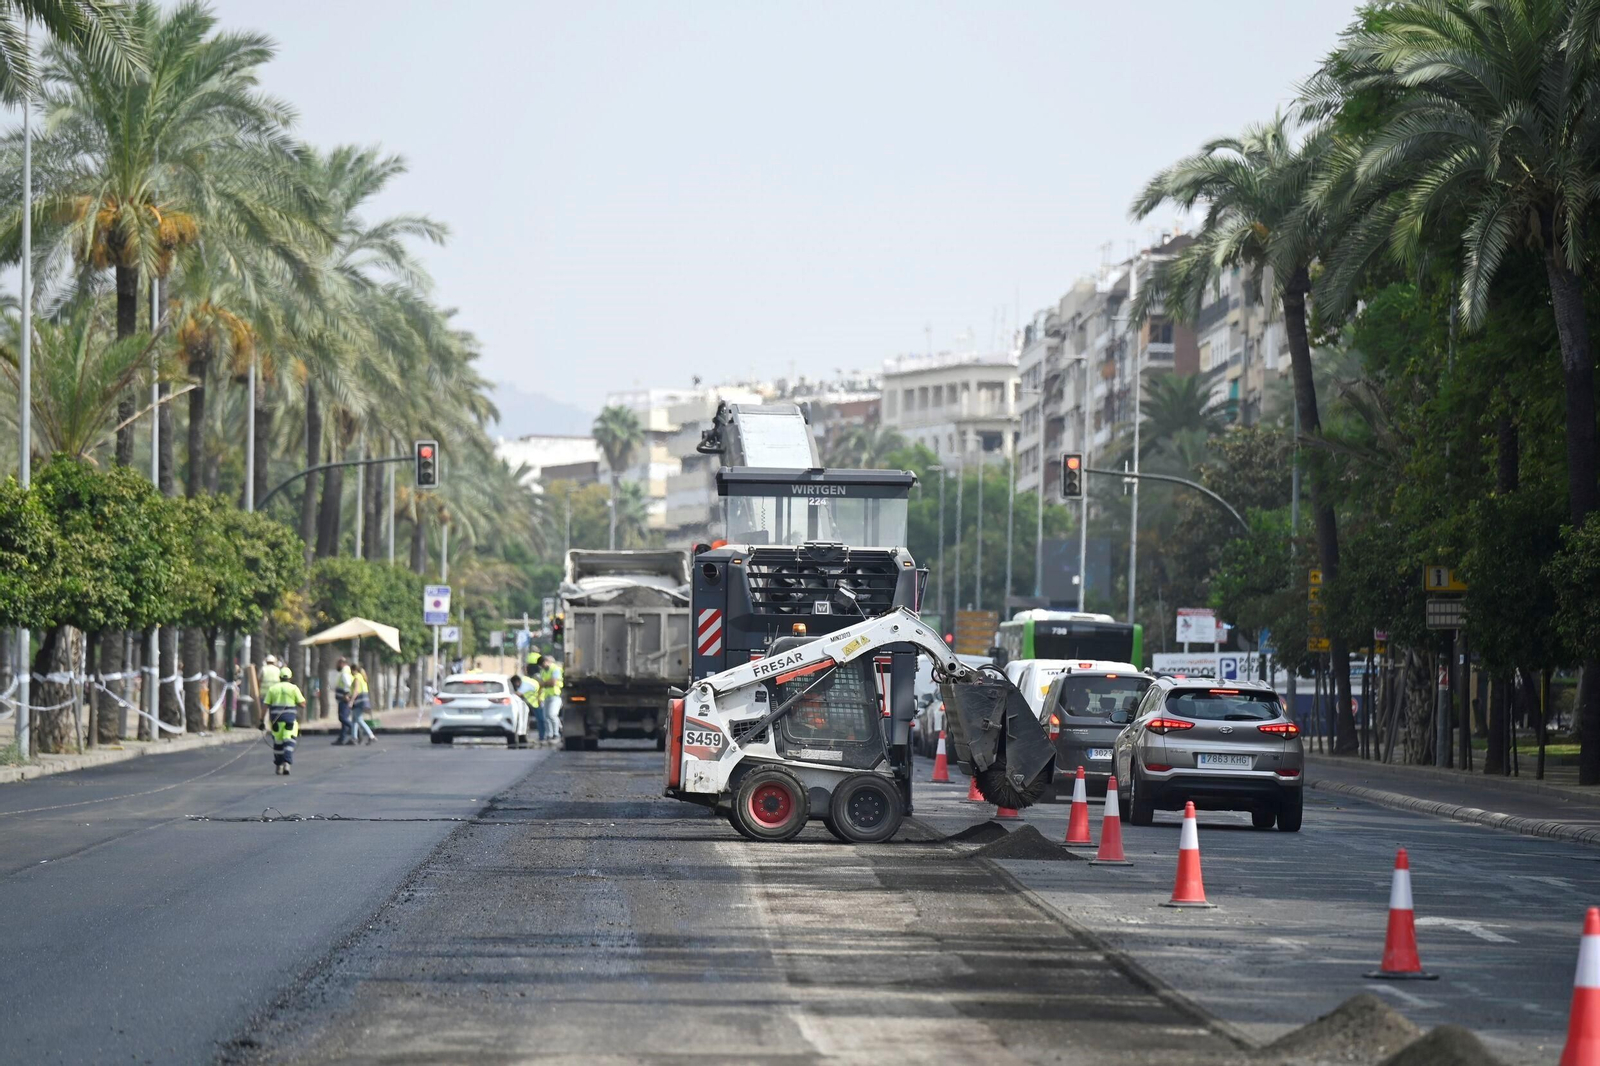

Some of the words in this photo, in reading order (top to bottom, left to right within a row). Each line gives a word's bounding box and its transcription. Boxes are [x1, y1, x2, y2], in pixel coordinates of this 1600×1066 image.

[791, 484, 846, 495] WIRTGEN
[752, 652, 804, 677] FRESAR
[686, 732, 721, 747] S459
[1206, 754, 1229, 763] 7863
[1230, 755, 1247, 764] KHG
